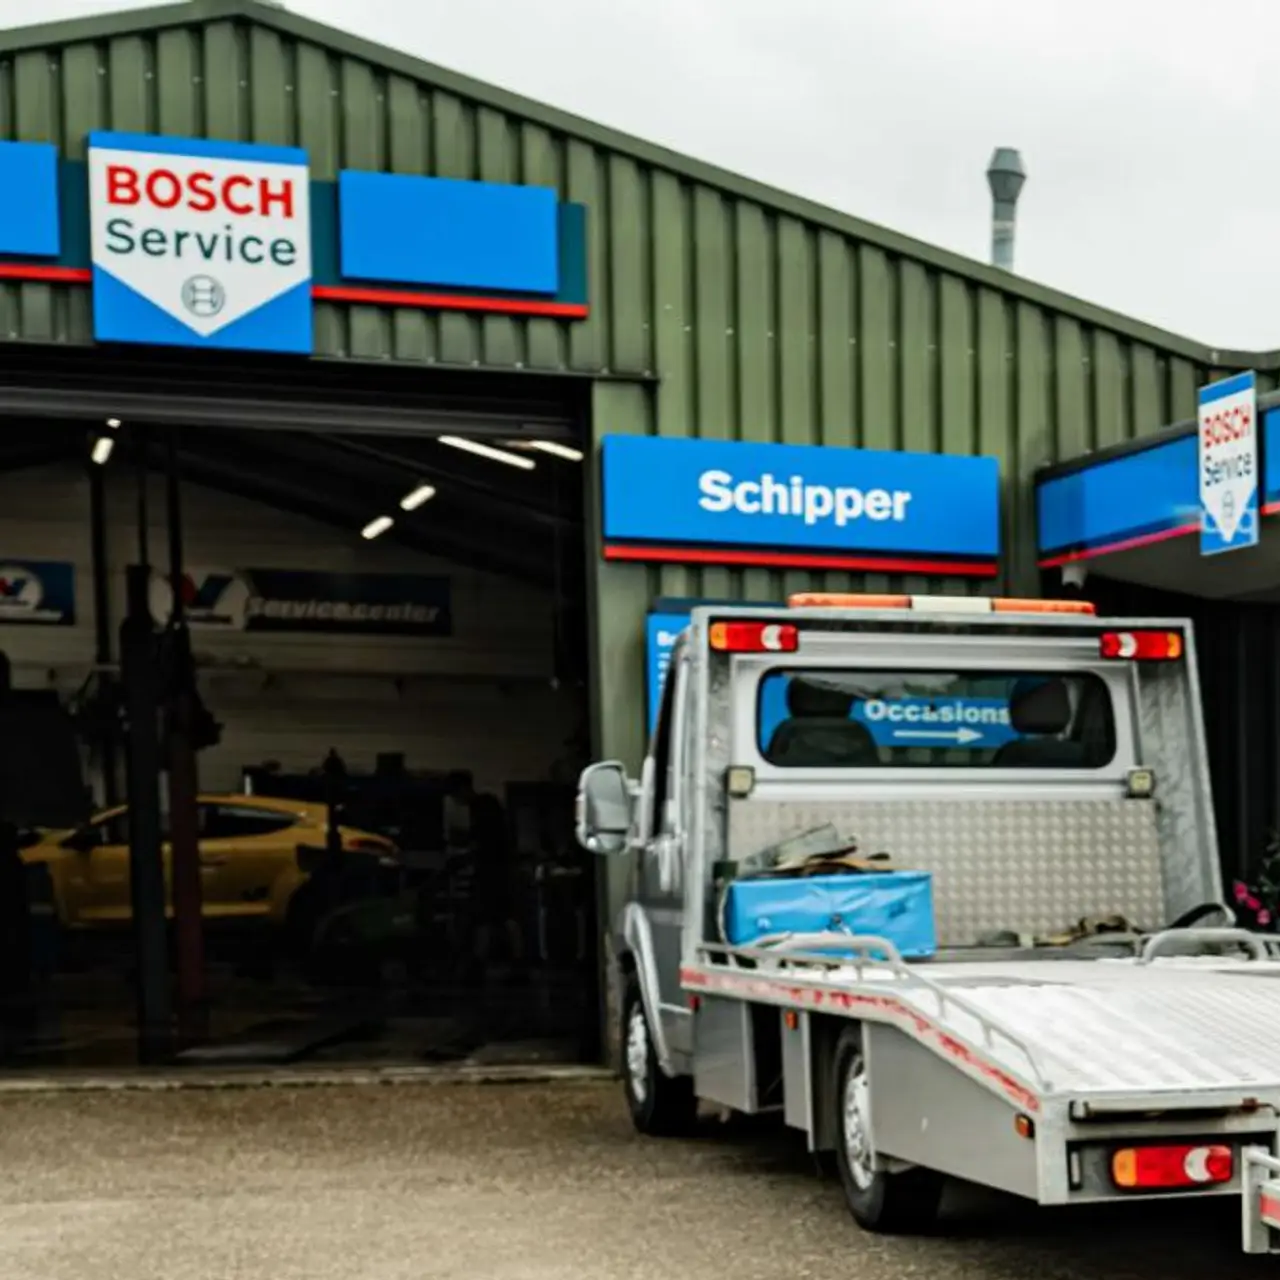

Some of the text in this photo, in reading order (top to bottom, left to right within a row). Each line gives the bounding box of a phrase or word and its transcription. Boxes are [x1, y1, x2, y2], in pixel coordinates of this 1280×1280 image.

[105, 164, 295, 219] BOSCH
[105, 218, 298, 268] Service
[1203, 404, 1251, 450] BOSCH
[1203, 454, 1252, 488] Service
[697, 470, 912, 527] Schipper
[864, 698, 1011, 726] Occasions
